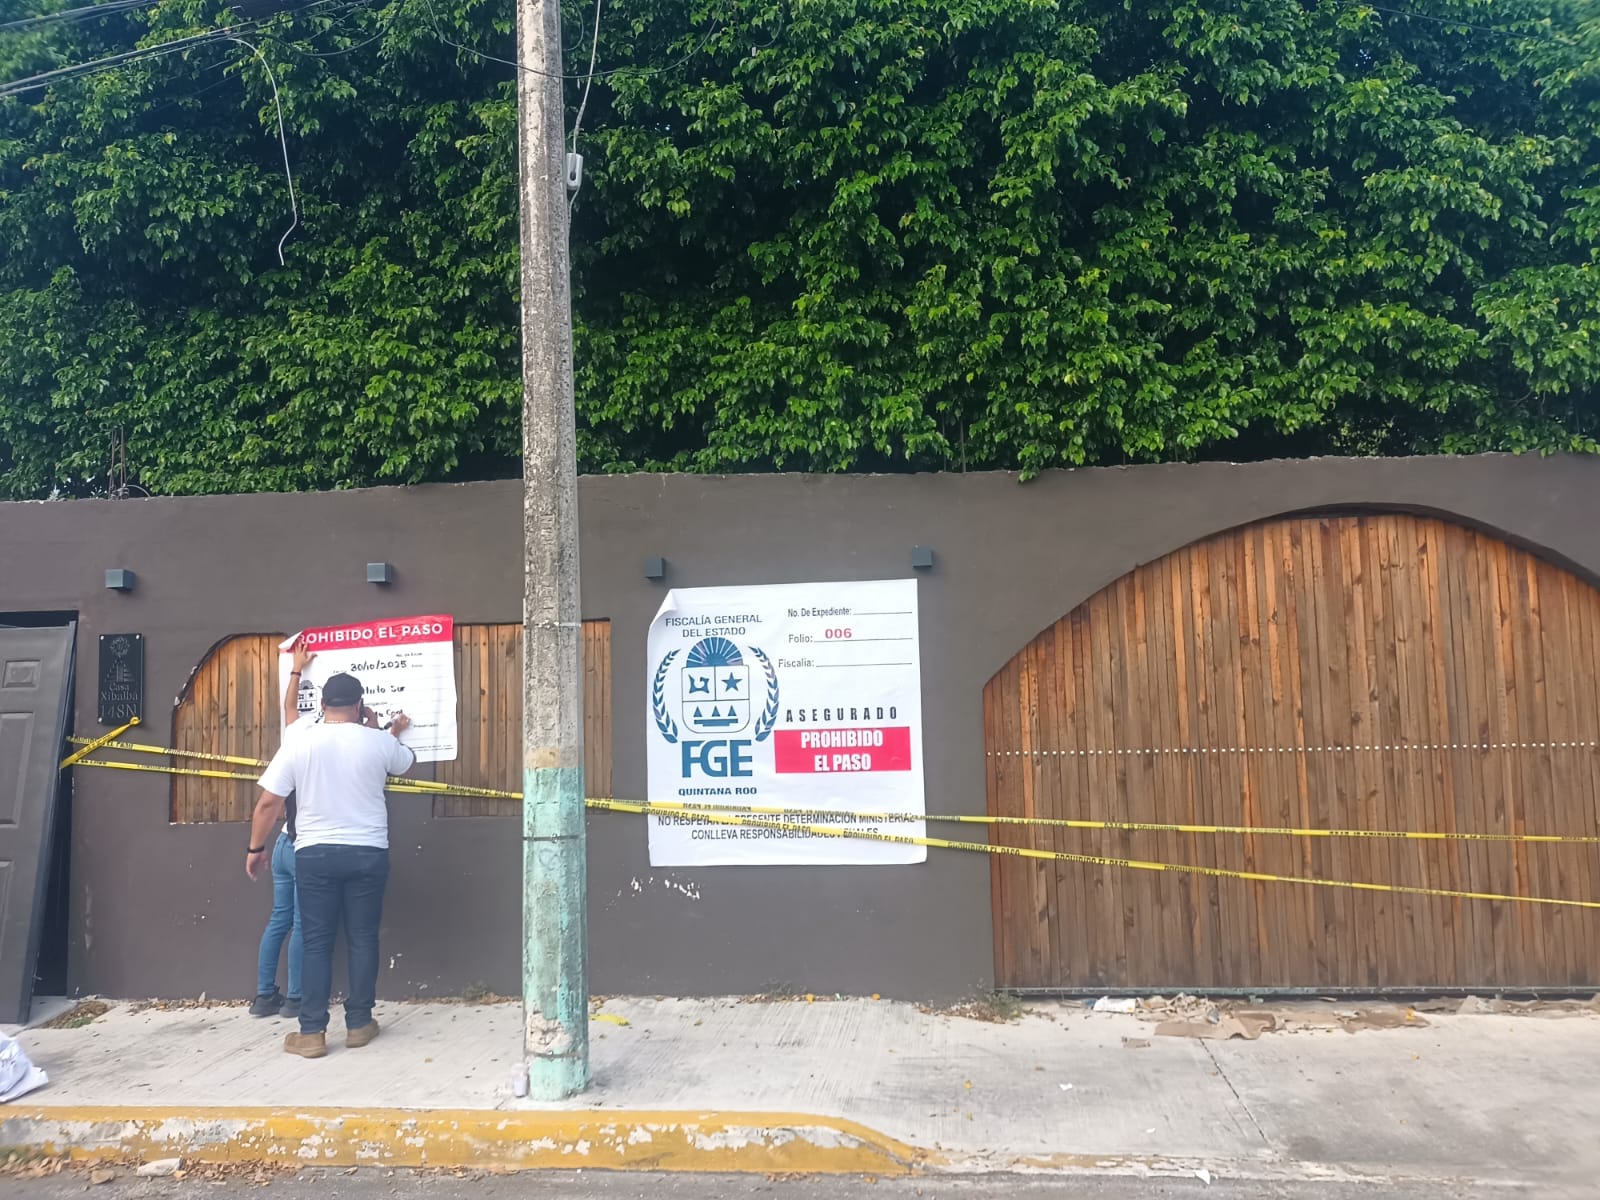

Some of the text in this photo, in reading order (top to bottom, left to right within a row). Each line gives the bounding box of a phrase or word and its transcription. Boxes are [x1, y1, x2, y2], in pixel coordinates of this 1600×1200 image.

[787, 606, 852, 618] No. De Expediente:
[665, 614, 763, 627] FISCALÍA GENERAL
[378, 628, 397, 638] EL
[402, 623, 443, 636] PASO
[682, 626, 746, 638] DEL ESTADO
[824, 628, 852, 639] 006
[788, 633, 814, 644] Folio:
[350, 659, 407, 672] 30/10/2025
[801, 730, 883, 749] PROHIBIDO
[681, 739, 753, 778] FGE
[814, 753, 872, 772] EL PASO
[678, 787, 757, 797] QUINTANA ROO
[658, 815, 672, 826] NO
[691, 829, 738, 840] CONLLEVA
